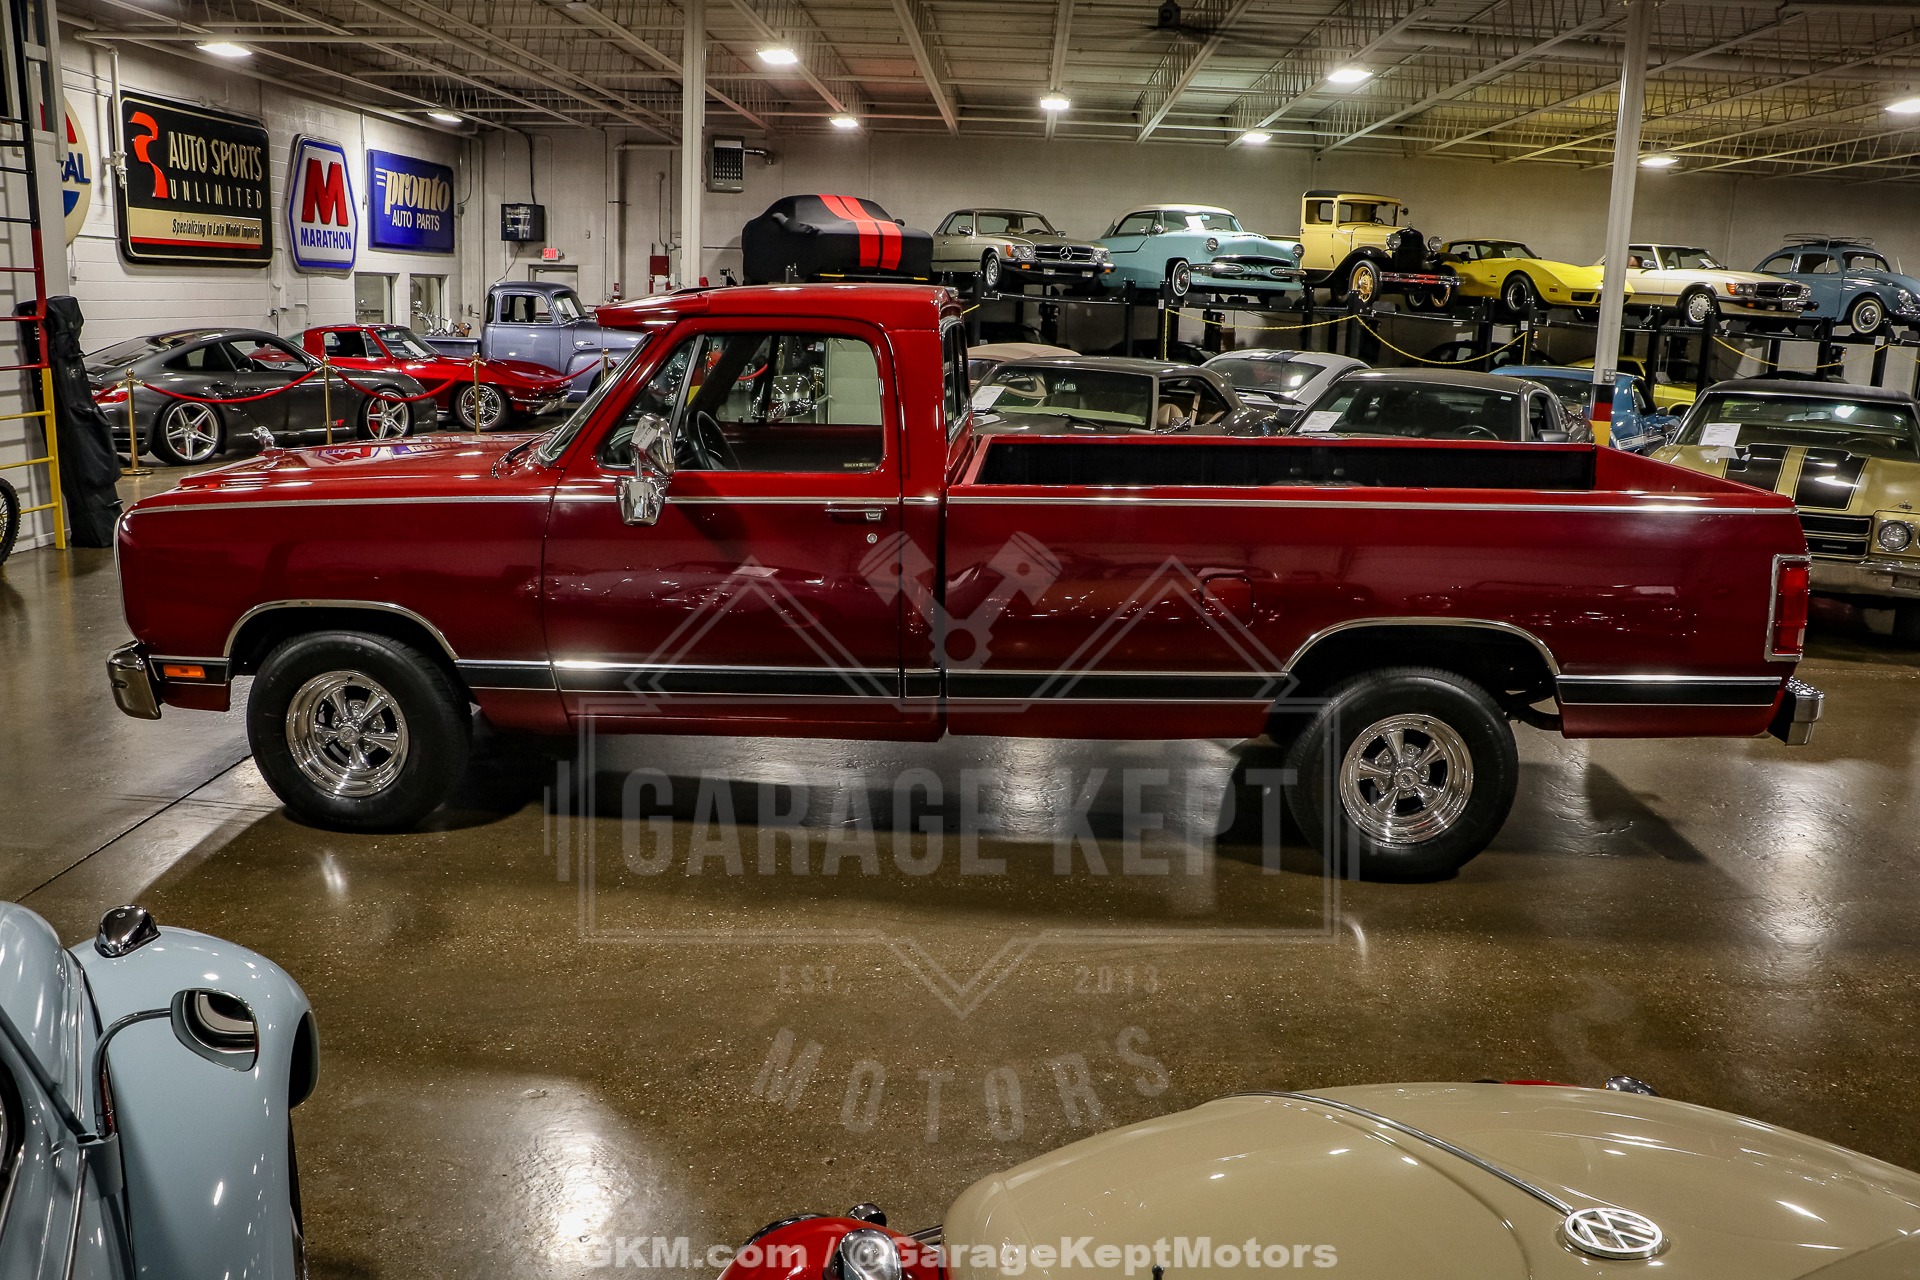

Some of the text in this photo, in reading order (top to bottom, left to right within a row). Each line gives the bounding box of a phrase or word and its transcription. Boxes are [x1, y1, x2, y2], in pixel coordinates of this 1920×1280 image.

[168, 131, 263, 182] AUTO SPORTS
[169, 178, 263, 209] UNLIMITED
[302, 157, 349, 227] M
[384, 170, 450, 214] pronto
[172, 218, 206, 238] Specializing
[213, 221, 225, 236] Late
[225, 222, 241, 238] Model
[241, 223, 260, 240] Imports
[391, 209, 441, 232] AUTO PARTS
[301, 227, 352, 249] MARATHON
[543, 247, 557, 259] EXIT
